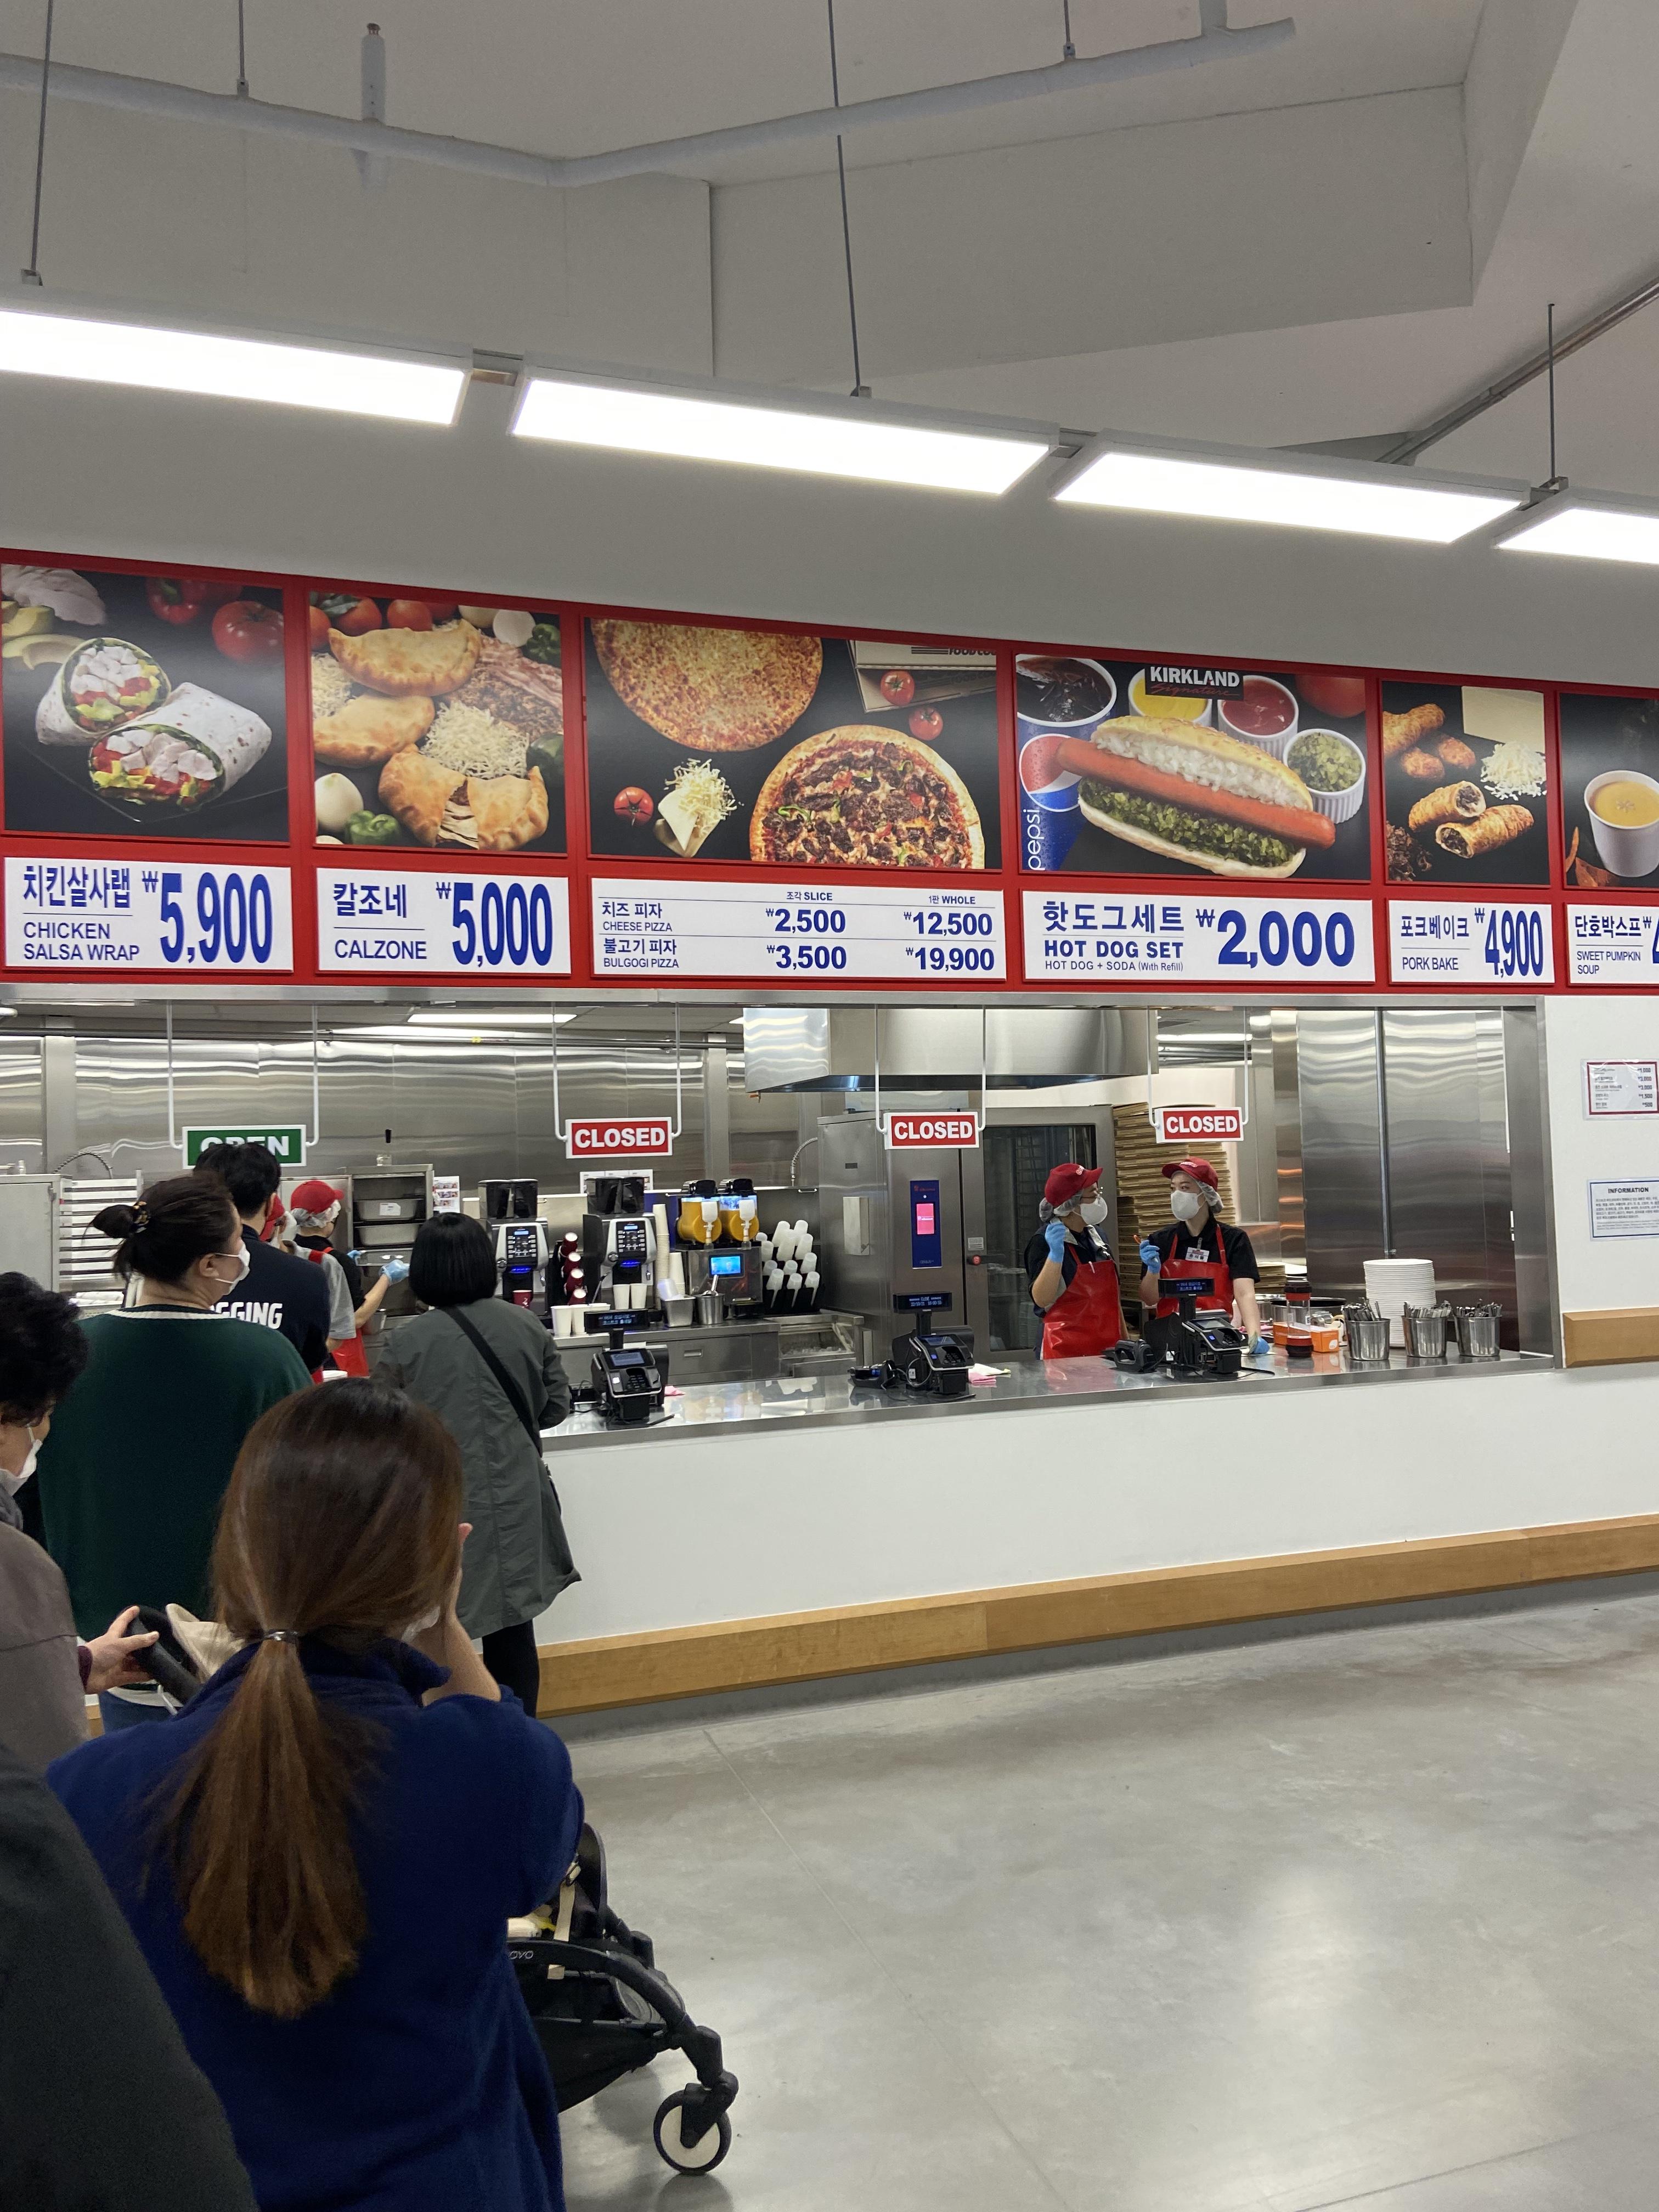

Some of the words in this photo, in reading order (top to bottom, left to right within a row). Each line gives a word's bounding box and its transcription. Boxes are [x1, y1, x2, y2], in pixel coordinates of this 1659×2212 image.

[1150, 667, 1240, 687] KIRKLAND
[1151, 683, 1240, 697] Signature
[1023, 809, 1046, 871] pepsi
[24, 866, 129, 908] 치킨살사랩
[334, 883, 407, 918] 칼조네
[787, 892, 802, 900] 조각
[804, 892, 832, 900] SLICE
[942, 896, 975, 904] WHOLE
[602, 902, 629, 917] 치즈
[635, 902, 662, 918] 피자
[1043, 901, 1184, 933] 핫도그세트
[24, 922, 110, 939] CHICKEN
[603, 922, 642, 930] CHEESE
[645, 922, 672, 932] PIZZA
[1401, 915, 1469, 939] 포크베이크
[1575, 915, 1641, 938] 단호박스프
[24, 944, 83, 960] SALSA
[87, 945, 139, 960] WRAP
[335, 940, 427, 959] CALZONE
[604, 938, 645, 954] 불고기
[650, 939, 676, 955] 피자
[1045, 940, 1086, 957] HOT
[1097, 941, 1138, 958] DOG
[1147, 941, 1183, 958] SET
[604, 958, 648, 967] BULGOGI
[651, 959, 679, 968] PIZZA
[1403, 957, 1430, 970] PORK
[1432, 957, 1458, 970] BAKE
[1577, 951, 1604, 960] SWEET
[1606, 951, 1640, 961] PUMPKIN
[1046, 961, 1066, 969] HOT
[1071, 961, 1093, 970] DOG
[1107, 962, 1136, 970] SODA
[1139, 961, 1158, 970] (With
[1161, 962, 1183, 971] Refill)
[1578, 965, 1599, 974] SOUP
[894, 1121, 973, 1139] CLOSED
[1166, 1116, 1238, 1133] CLOSED
[575, 1127, 665, 1148] CLOSED
